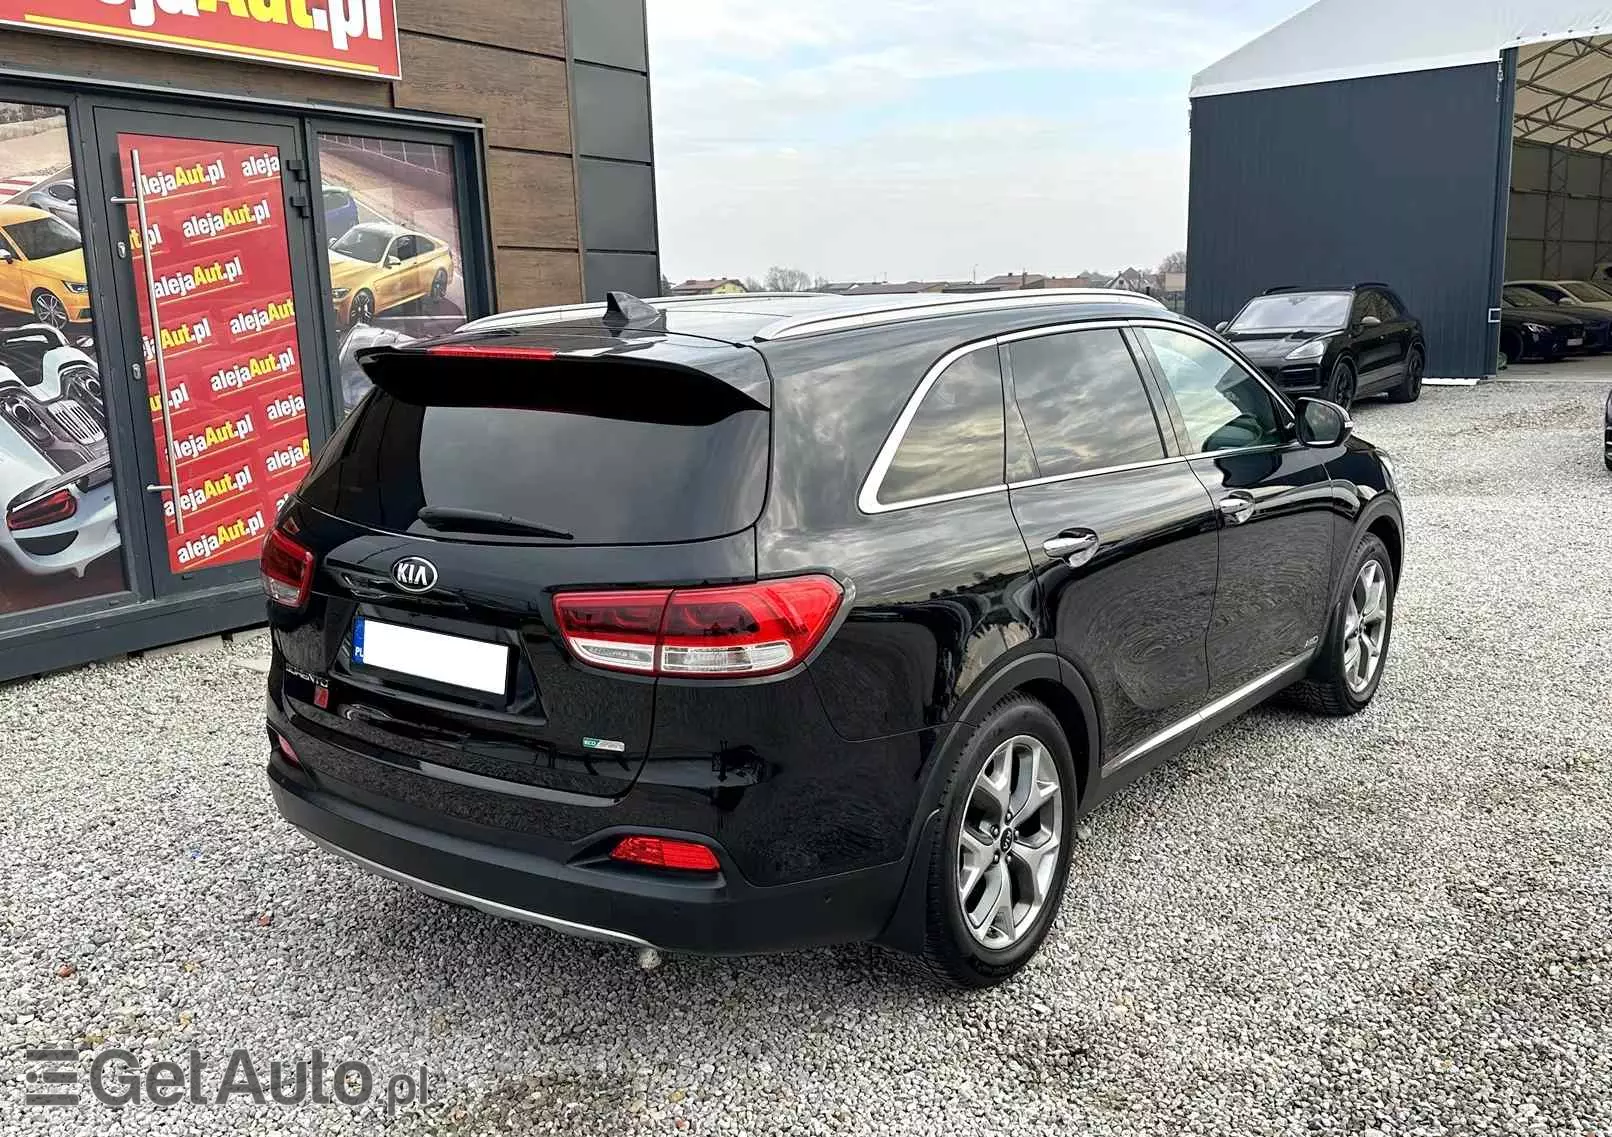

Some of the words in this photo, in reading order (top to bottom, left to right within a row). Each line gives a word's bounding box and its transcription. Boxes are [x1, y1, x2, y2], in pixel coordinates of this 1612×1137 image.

[132, 160, 225, 196] lejaAut.pl
[241, 153, 280, 177] aleja
[182, 200, 271, 237] alejaAut.pl
[154, 256, 243, 298] alejaAut.pl
[210, 347, 296, 391] alejaAut.pl
[266, 395, 305, 421] aleja
[164, 413, 254, 461] lejaAut.pl
[163, 465, 253, 516] aejaAut.pl
[177, 511, 265, 564] alejaAut.pl
[397, 562, 428, 586] KIA
